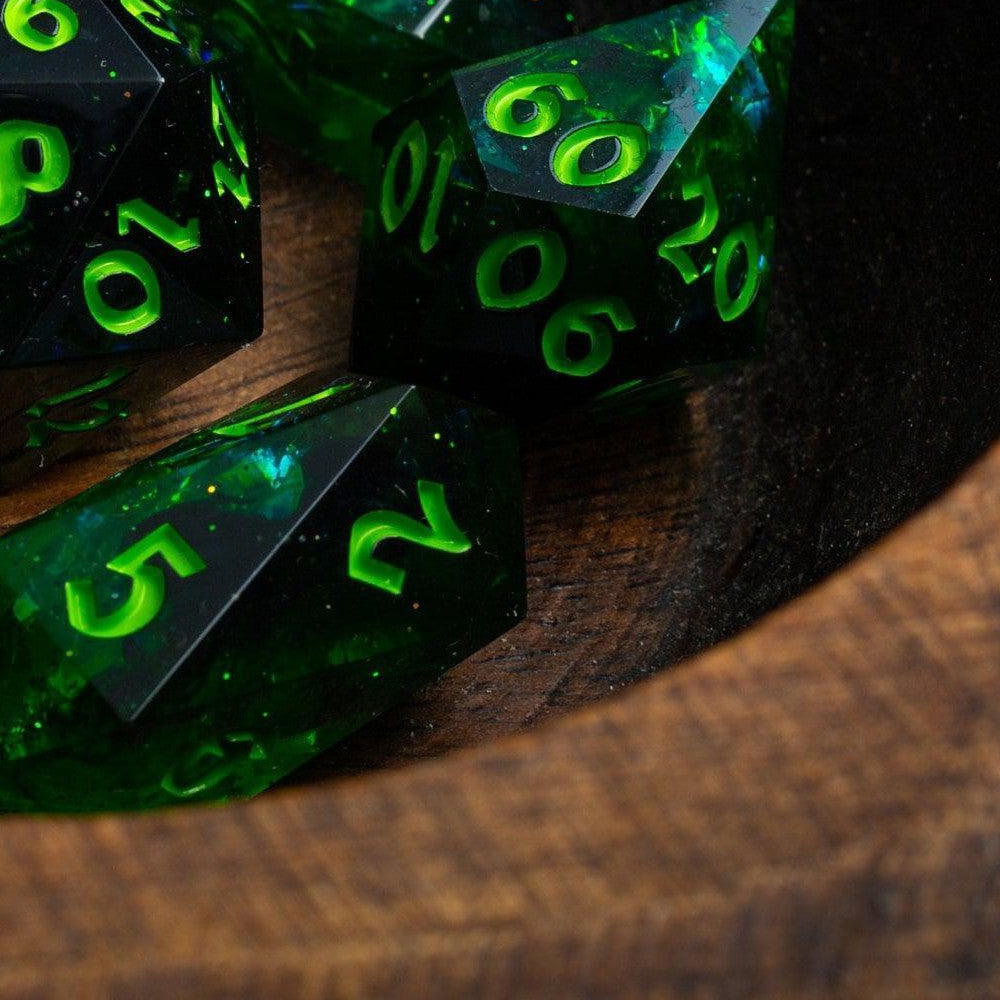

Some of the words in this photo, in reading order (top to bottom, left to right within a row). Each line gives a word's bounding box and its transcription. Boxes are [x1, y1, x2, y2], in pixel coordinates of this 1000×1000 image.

[483, 70, 645, 188] 60
[81, 198, 201, 336] 10
[63, 521, 208, 639] 5
[347, 478, 473, 595] 2
